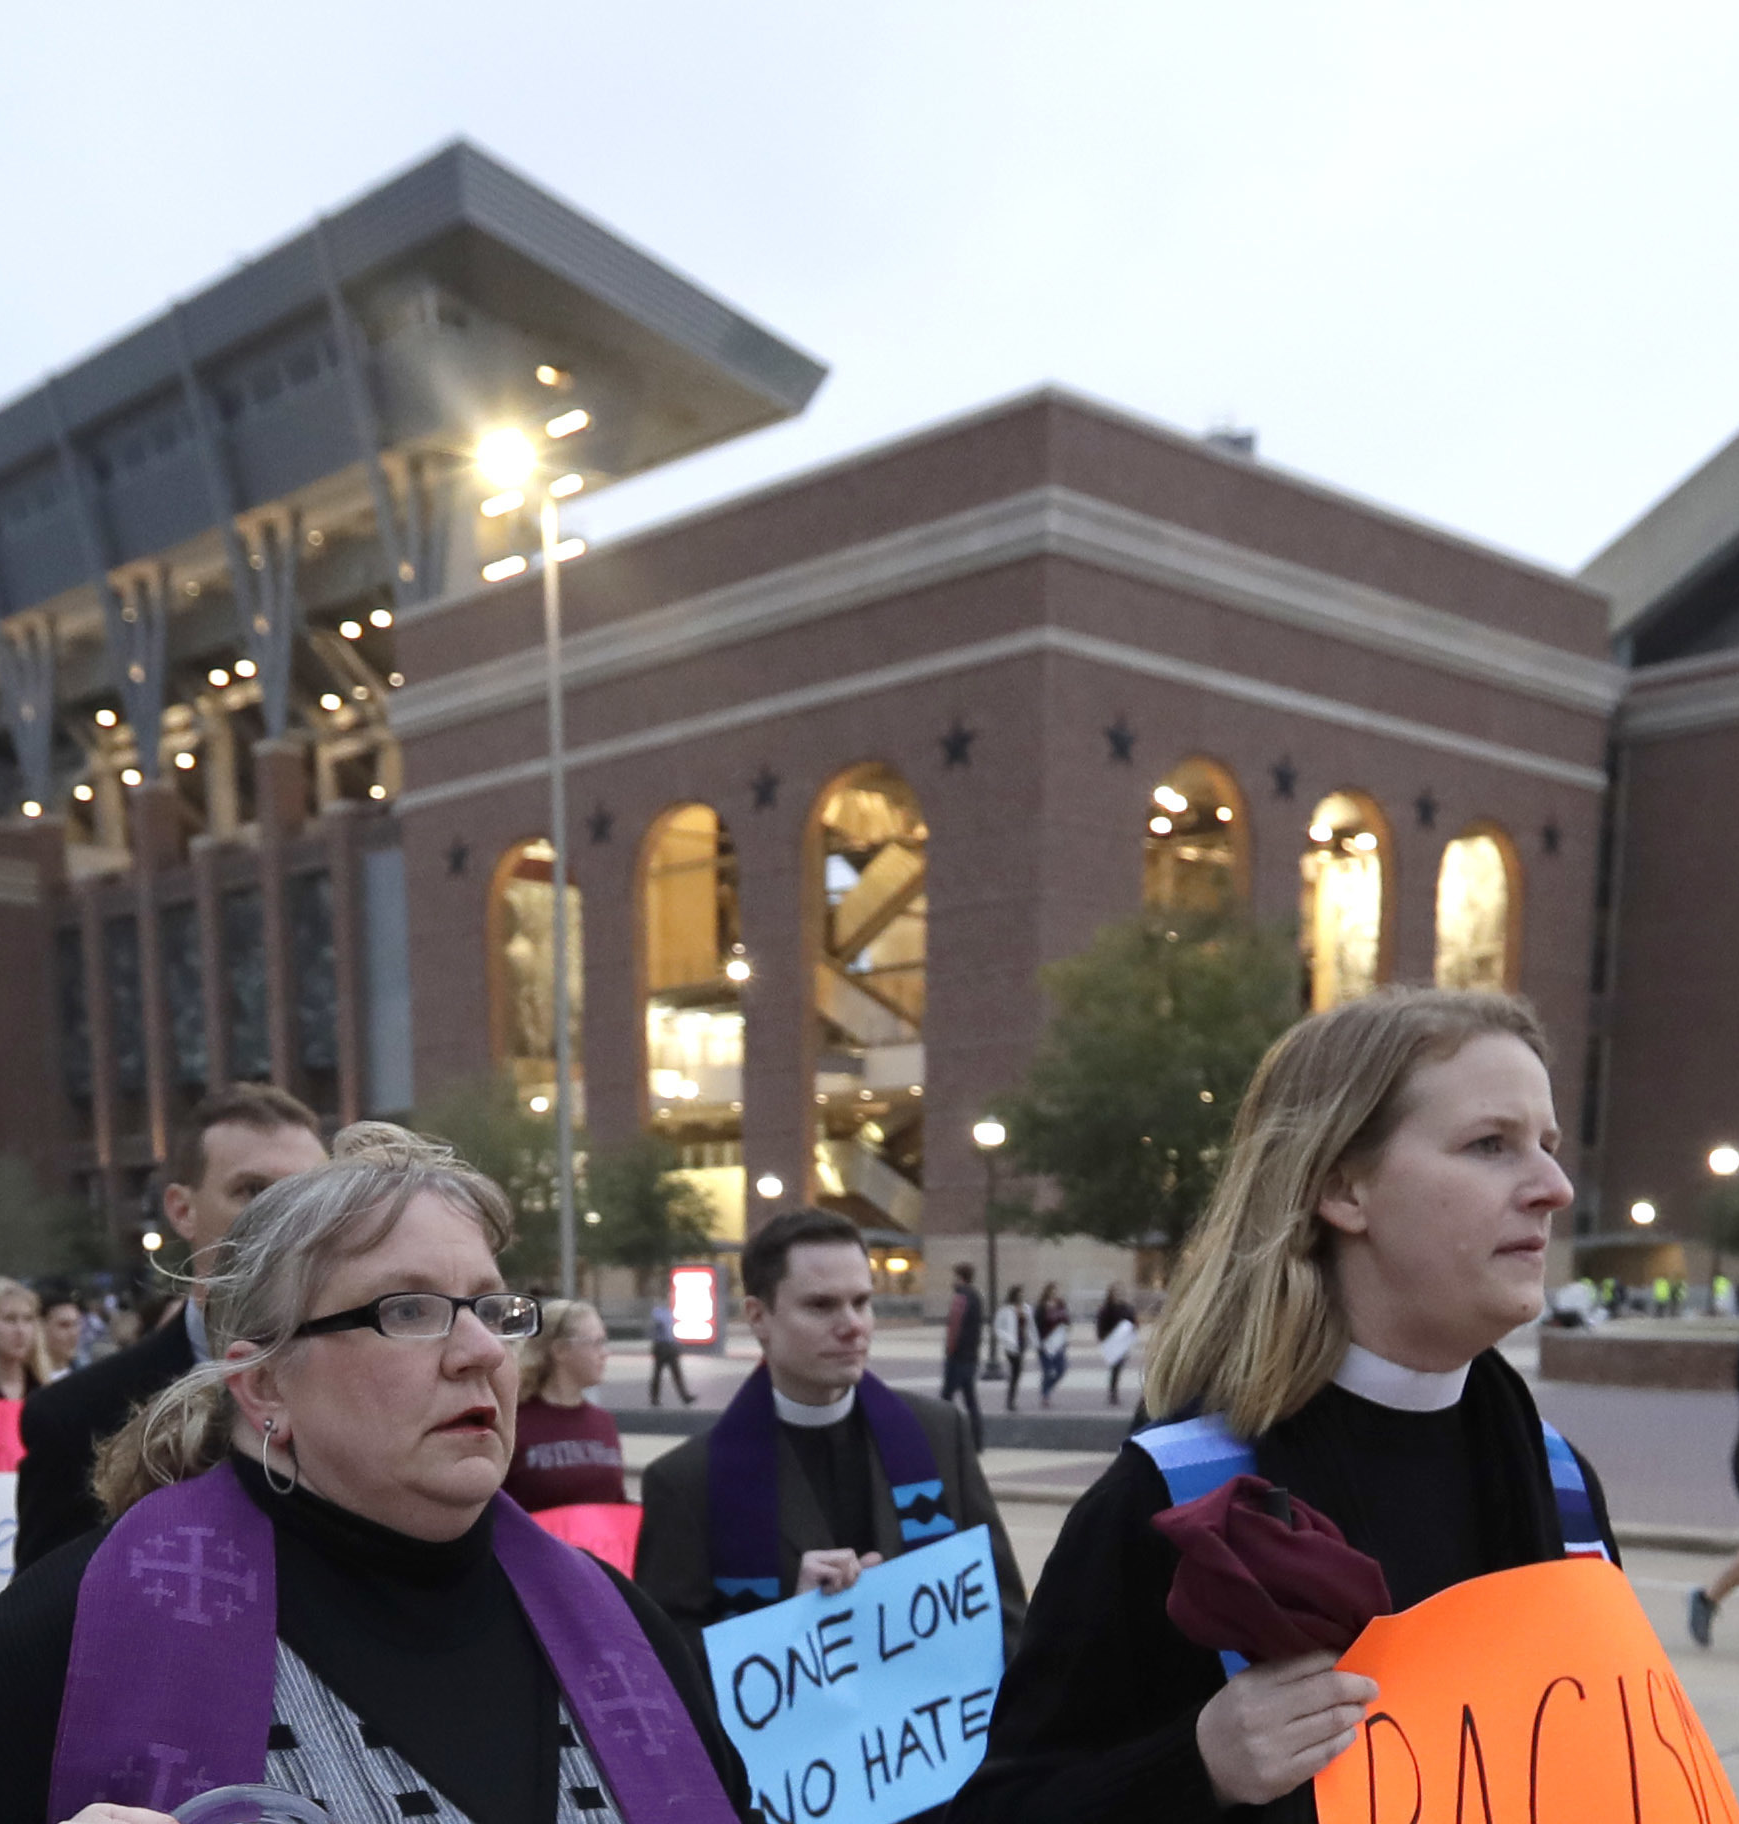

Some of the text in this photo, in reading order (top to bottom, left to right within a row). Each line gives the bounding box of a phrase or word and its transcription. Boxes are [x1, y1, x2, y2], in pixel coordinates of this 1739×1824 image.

[733, 1559, 990, 1731] ONE LOVE
[861, 1687, 993, 1802] HATE
